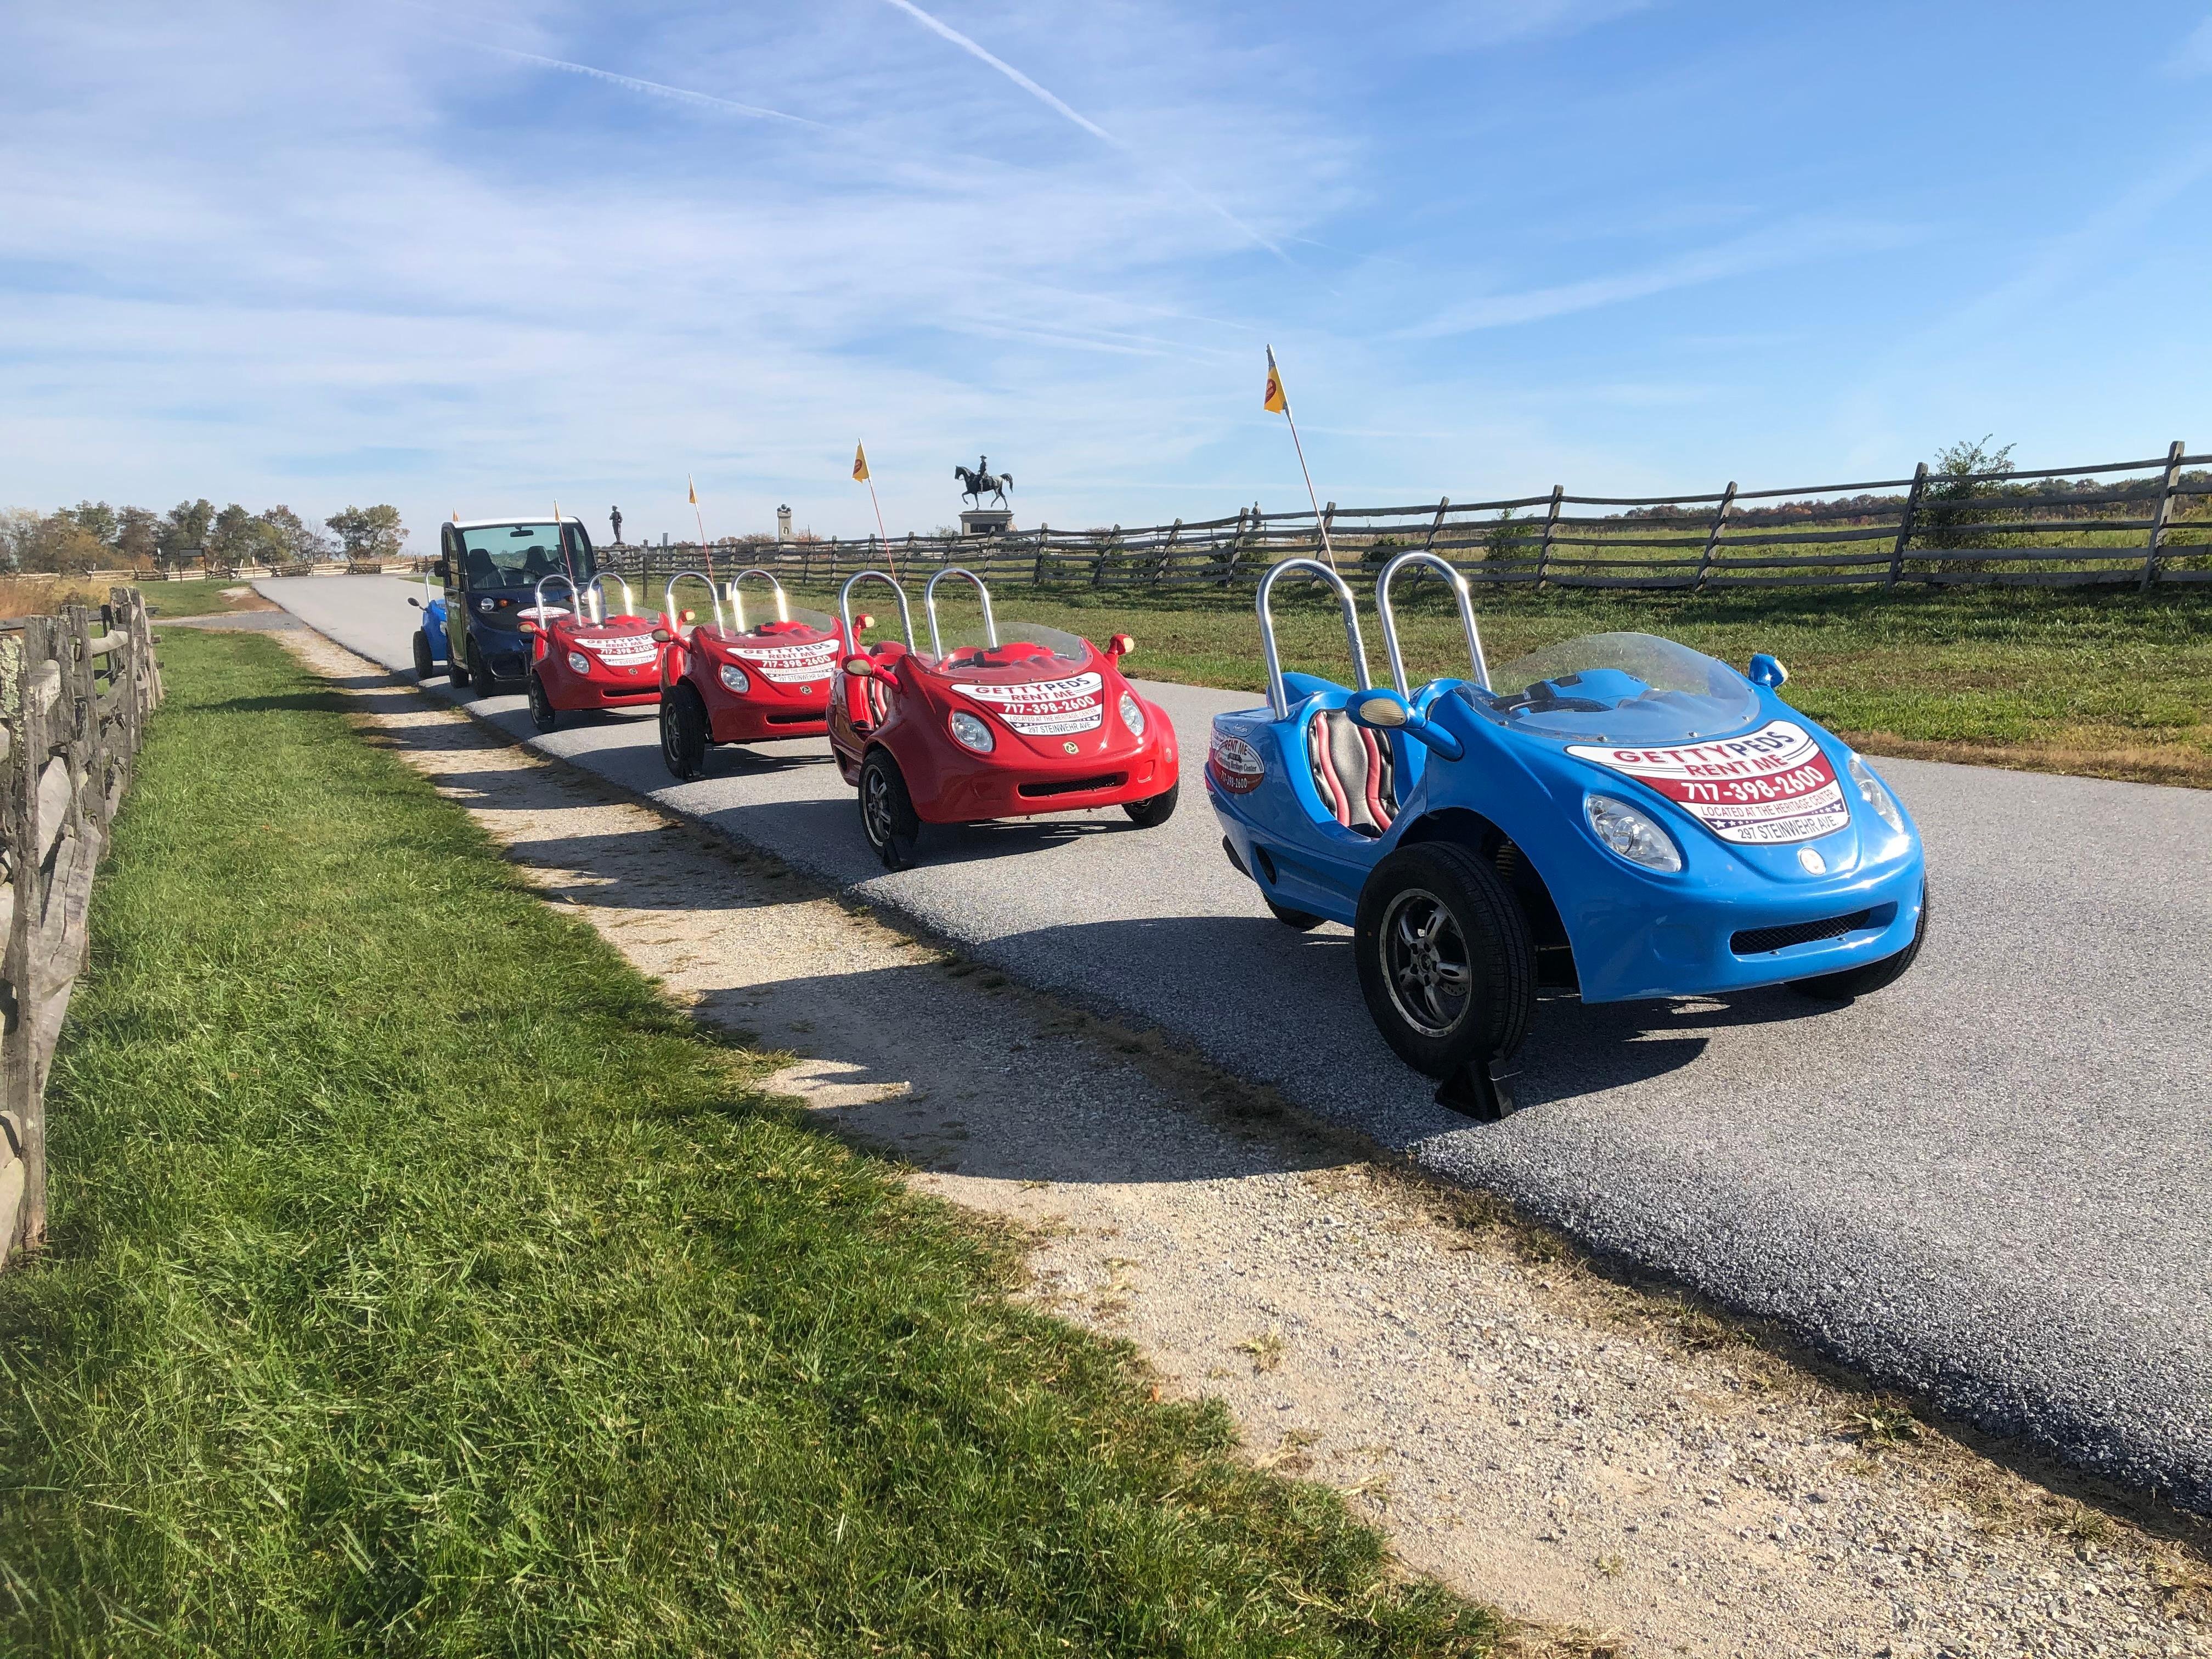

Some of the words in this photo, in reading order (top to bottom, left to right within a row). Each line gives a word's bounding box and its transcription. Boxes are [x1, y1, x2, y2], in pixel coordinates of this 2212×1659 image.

[600, 644, 654, 654] 717-398-2600
[743, 643, 831, 654] GETTYPEDS
[761, 655, 831, 668] 717-398-2600
[975, 678, 1090, 695] GETTYPEDS
[1054, 690, 1075, 699] ME
[1003, 696, 1096, 714] 717-398-2600
[1054, 713, 1079, 721] HERITAGE
[1079, 708, 1097, 716] CENTER
[1040, 723, 1077, 733] STEINWEHR
[1224, 739, 1238, 752] RENT
[1238, 742, 1248, 755] ME
[1612, 731, 1795, 764] GETTYPEDS
[1684, 760, 1752, 777] RENT
[1751, 754, 1788, 771] ME
[1221, 770, 1247, 788] 717-398-2600
[1681, 765, 1826, 802] 717-398-2600
[1701, 806, 1744, 817] LOCATED
[1745, 806, 1756, 816] AT
[1757, 804, 1775, 816] THE
[1775, 798, 1811, 814] HERITAGE
[1811, 789, 1837, 805] CENTER
[1737, 827, 1757, 840] 297
[1757, 818, 1818, 840] STEINWEHR
[1815, 815, 1839, 830] AVE.
